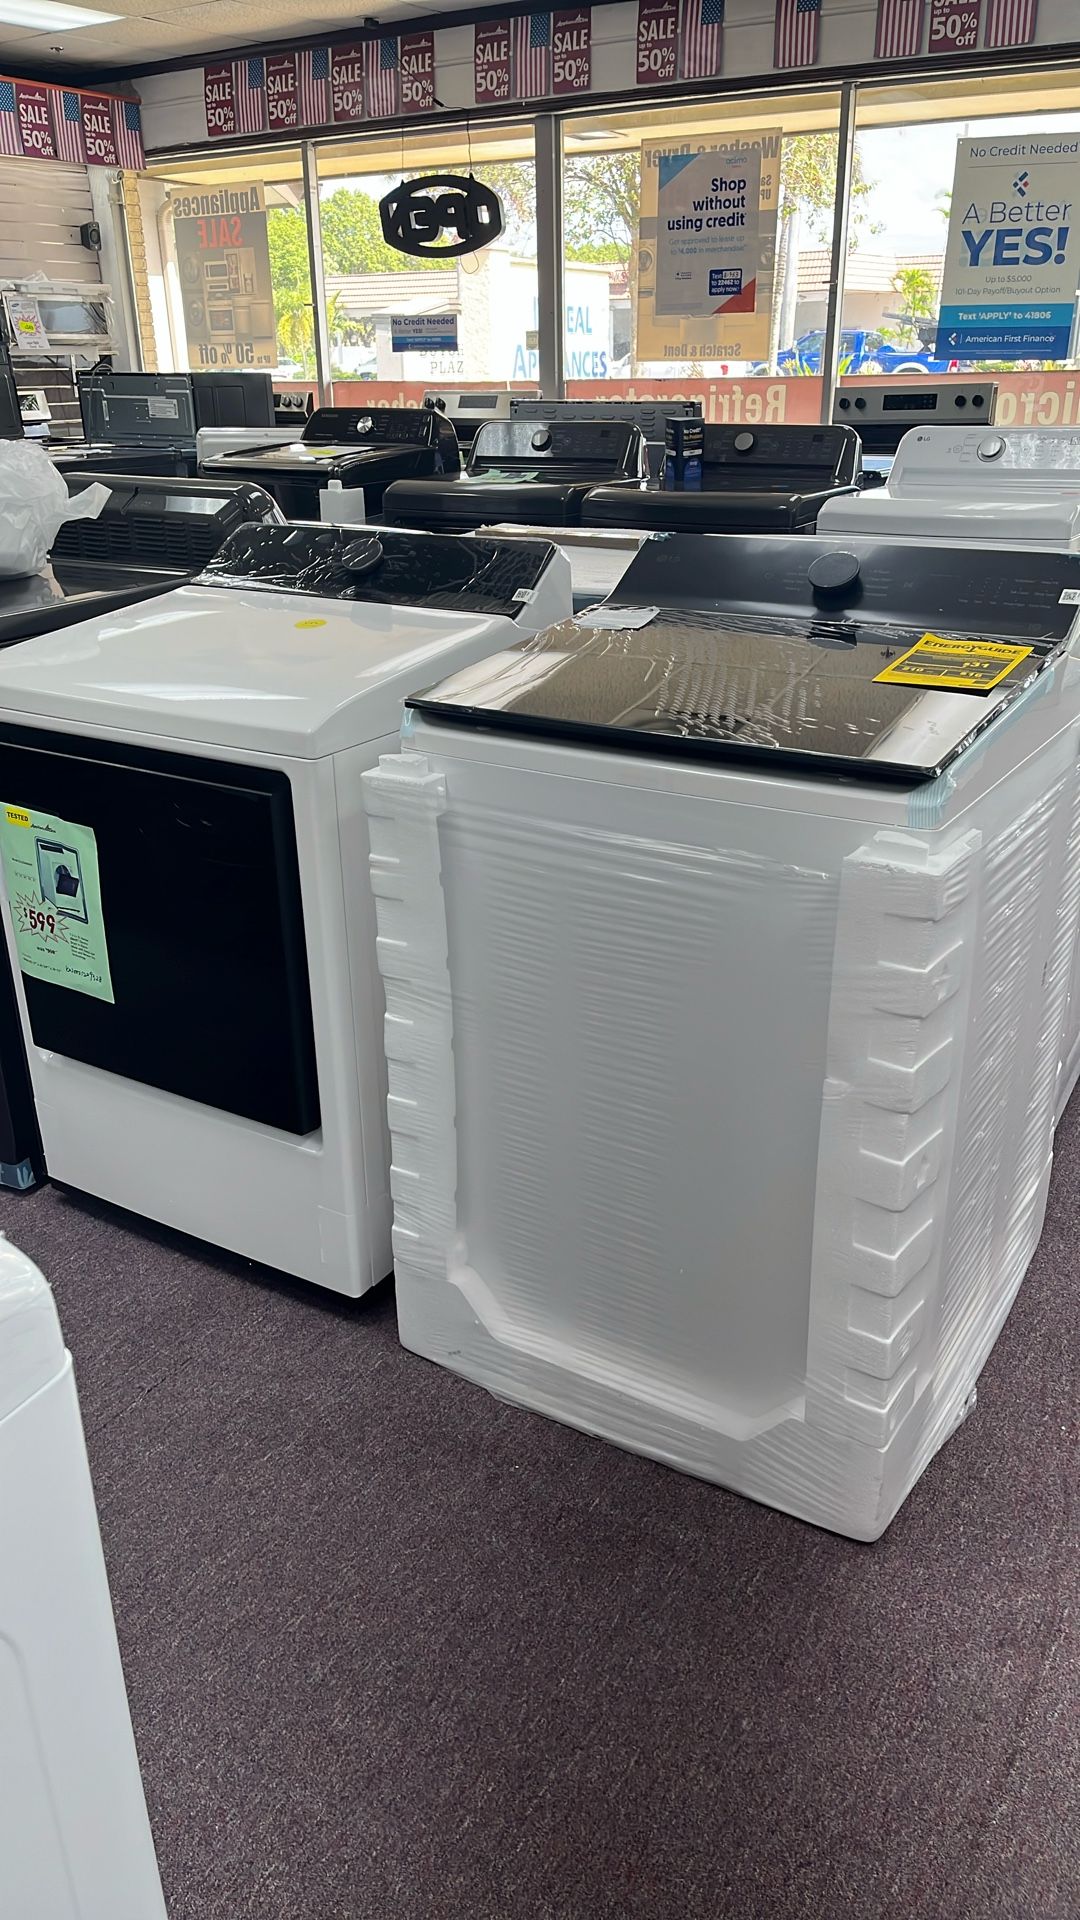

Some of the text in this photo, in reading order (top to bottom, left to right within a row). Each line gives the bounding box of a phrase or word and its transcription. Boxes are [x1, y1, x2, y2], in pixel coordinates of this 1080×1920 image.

[638, 18, 675, 42] SALE
[931, 12, 977, 40] 50%
[554, 29, 588, 54] SALE
[955, 31, 976, 46] off
[476, 40, 508, 64] SALE
[638, 47, 675, 72] 50%
[401, 53, 432, 76] SALE
[554, 57, 589, 82] 50%
[658, 64, 674, 78] off
[267, 73, 294, 94] SALE
[333, 64, 361, 86] SALE
[476, 68, 509, 92] 50%
[573, 74, 589, 87] off
[206, 82, 232, 102] SALE
[402, 80, 434, 102] 50%
[494, 84, 509, 97] off
[269, 98, 296, 120] 50%
[334, 89, 362, 112] 50%
[420, 95, 433, 107] off
[20, 104, 48, 125] SALE
[208, 106, 234, 128] 50%
[284, 113, 297, 124] off
[350, 104, 362, 116] off
[84, 114, 112, 134] SALE
[222, 121, 234, 132] off
[22, 129, 52, 148] 50%
[86, 138, 114, 156] 50%
[41, 146, 54, 156] off
[104, 154, 116, 164] off
[970, 142, 1078, 158] No Credit Needed
[711, 178, 746, 193] Shop
[693, 195, 745, 211] without
[962, 202, 1072, 224] A Better
[668, 216, 702, 232] using
[961, 227, 1070, 266] YES!
[985, 276, 996, 284] Up
[1034, 286, 1061, 294] Option
[404, 318, 426, 326] Credit
[426, 316, 455, 325] Needed
[958, 312, 976, 320] Text
[965, 334, 1056, 344] American First Finance
[6, 812, 28, 821] TESTED
